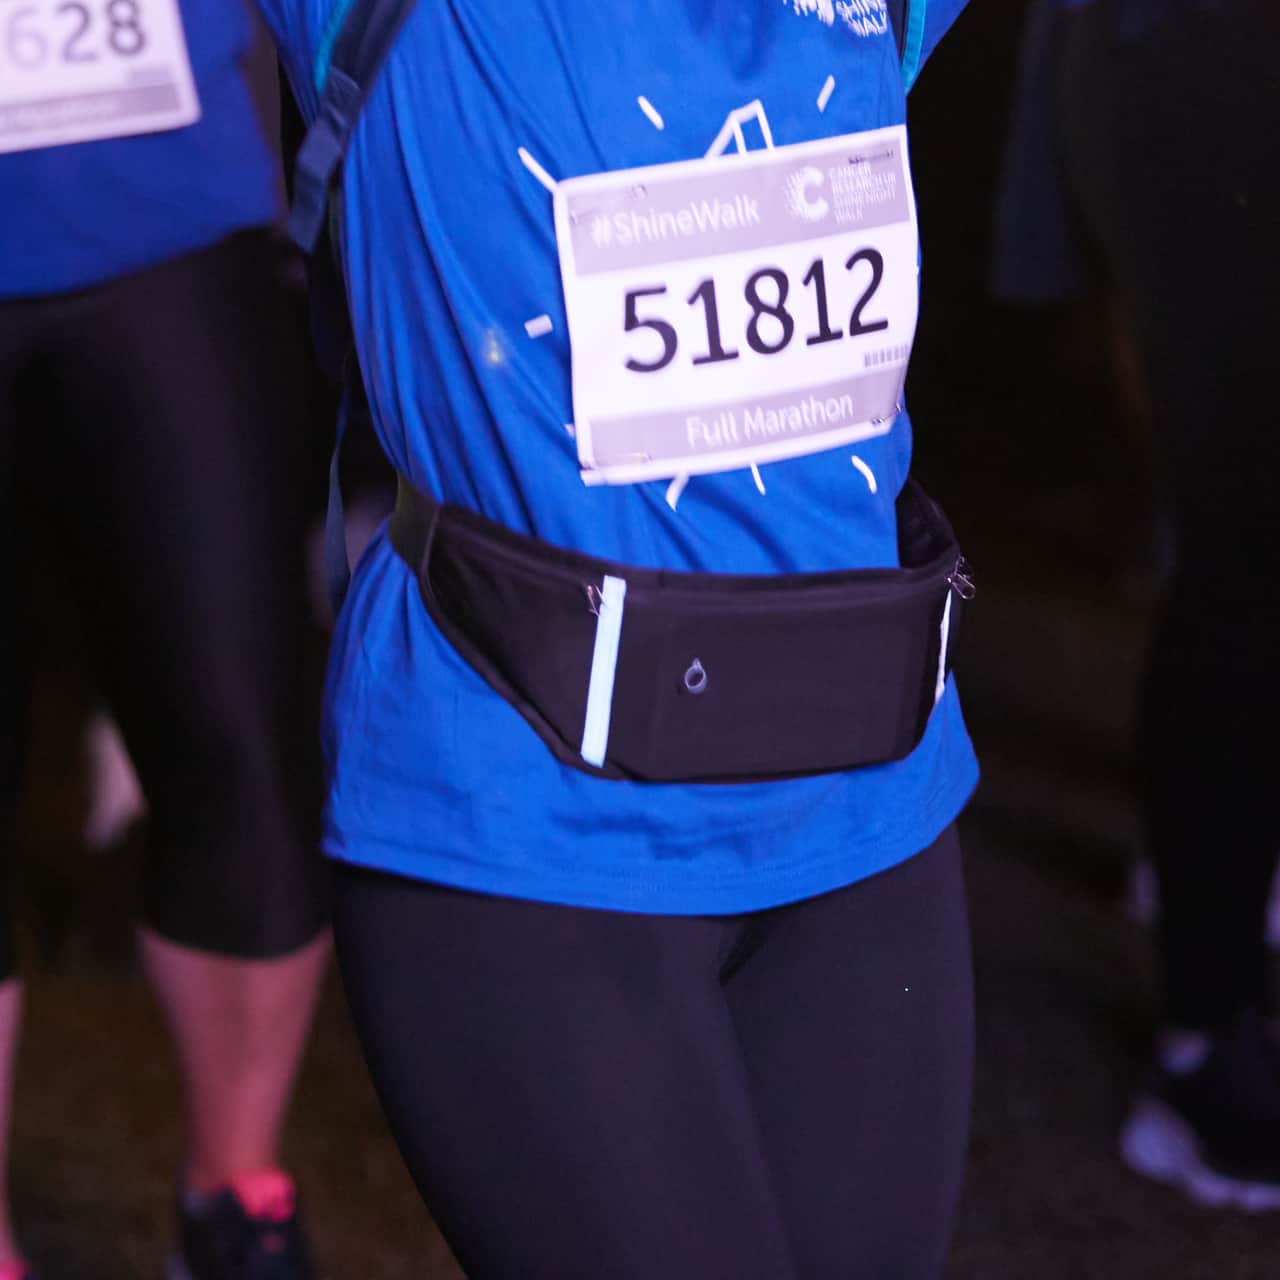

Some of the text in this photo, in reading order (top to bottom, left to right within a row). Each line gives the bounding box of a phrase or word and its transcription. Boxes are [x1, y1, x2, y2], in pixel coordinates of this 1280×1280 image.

[591, 193, 761, 249] #ShineWalk
[623, 247, 890, 375] 51812
[685, 393, 856, 450] Full Marathon
